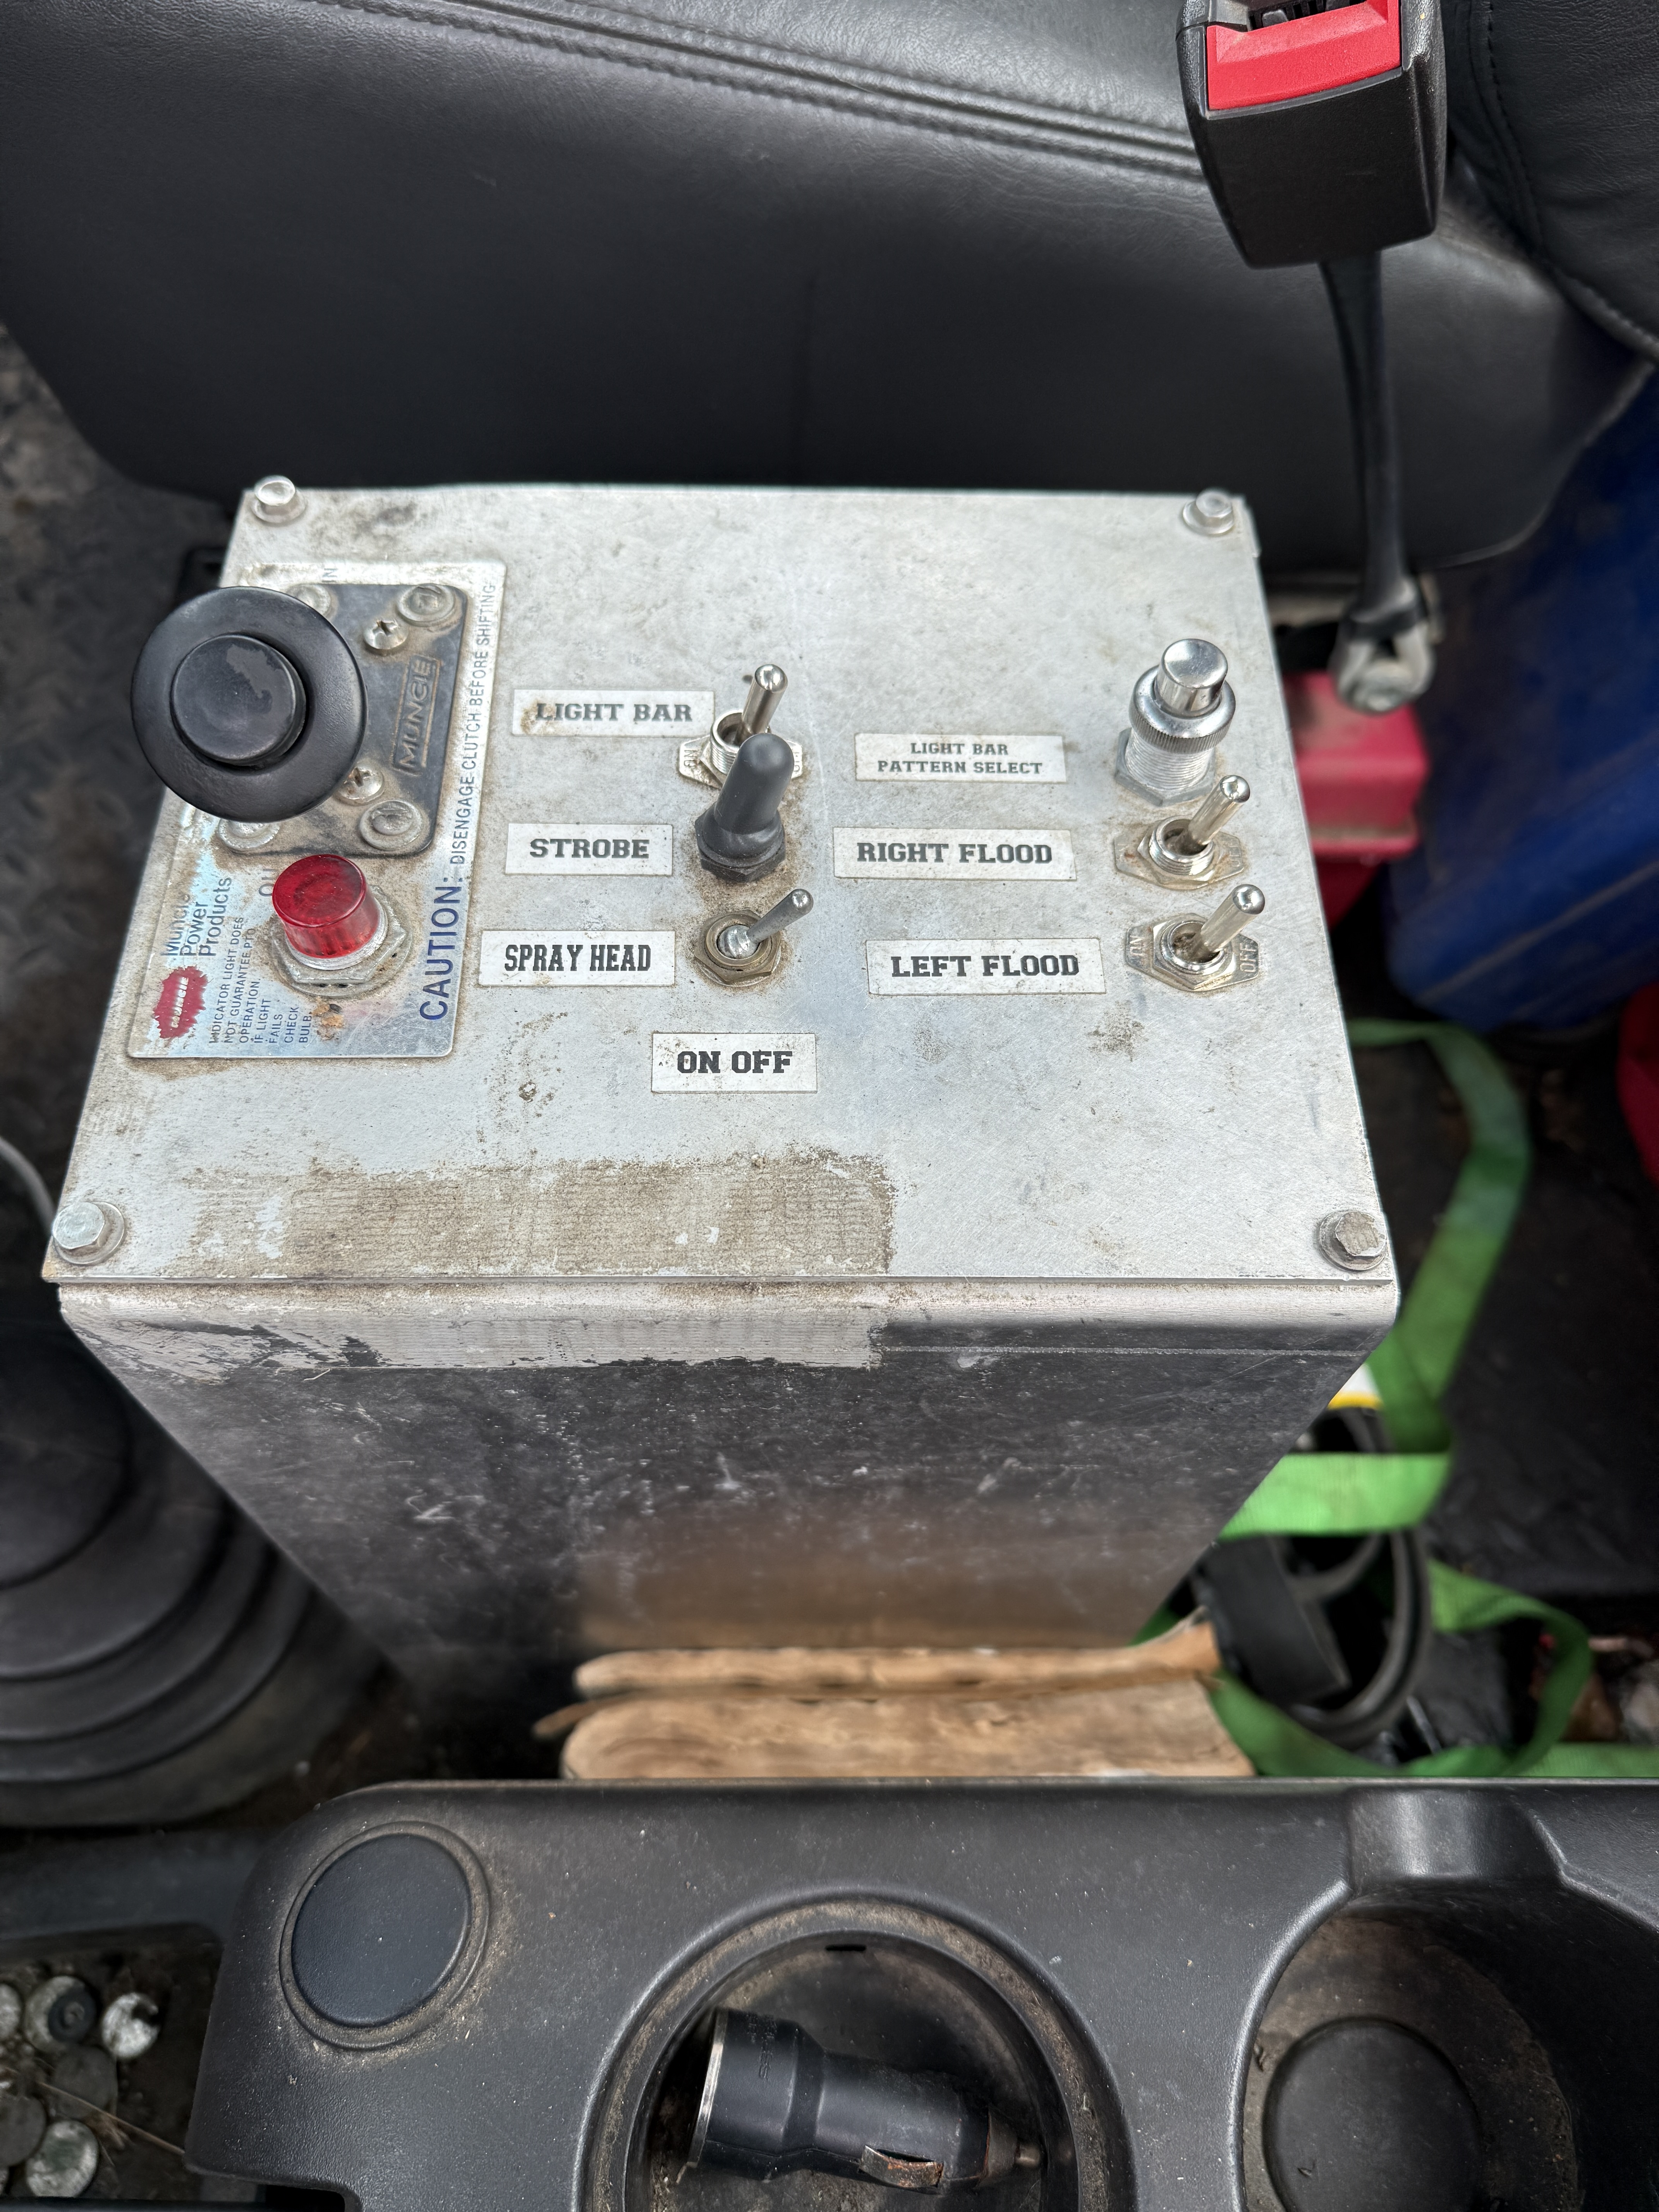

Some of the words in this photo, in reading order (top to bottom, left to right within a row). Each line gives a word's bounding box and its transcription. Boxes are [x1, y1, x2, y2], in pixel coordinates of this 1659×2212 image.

[476, 584, 496, 646] SHIFTING
[469, 651, 488, 706] BEFORE
[398, 659, 431, 768] MUNCIE
[535, 703, 624, 721] LIGHT
[634, 704, 692, 722] BAR
[462, 713, 482, 770] CLUTCH
[910, 742, 965, 755] LIGHT
[972, 743, 1008, 755] BAR
[878, 760, 966, 773] PATTERN
[973, 762, 1043, 774] SELECT
[450, 776, 475, 864] DISENGAGE
[530, 838, 650, 859] STROBE
[857, 842, 949, 863] RIGHT
[958, 844, 1052, 864] FLOOD
[179, 901, 209, 956] Power
[198, 877, 232, 956] Products
[223, 949, 237, 980] LIGHT
[230, 917, 244, 945] DOES
[244, 928, 256, 948] PTO
[420, 877, 463, 1020] CAUTION:
[505, 944, 584, 972] SPRAY
[589, 944, 651, 971] HEAD
[891, 956, 972, 977] LEFT
[981, 955, 1079, 977] FLOOD
[1239, 943, 1257, 973] OFF
[230, 952, 251, 1016] GUARANTEE
[239, 979, 261, 1043] OPERATION.
[256, 998, 271, 1030] LIGHT
[284, 1006, 300, 1043] CHECK
[224, 1020, 237, 1043] NOT
[254, 1034, 264, 1043] IF
[269, 1013, 283, 1043] FAILS
[677, 1051, 721, 1073] ON
[732, 1050, 793, 1073] OFF
